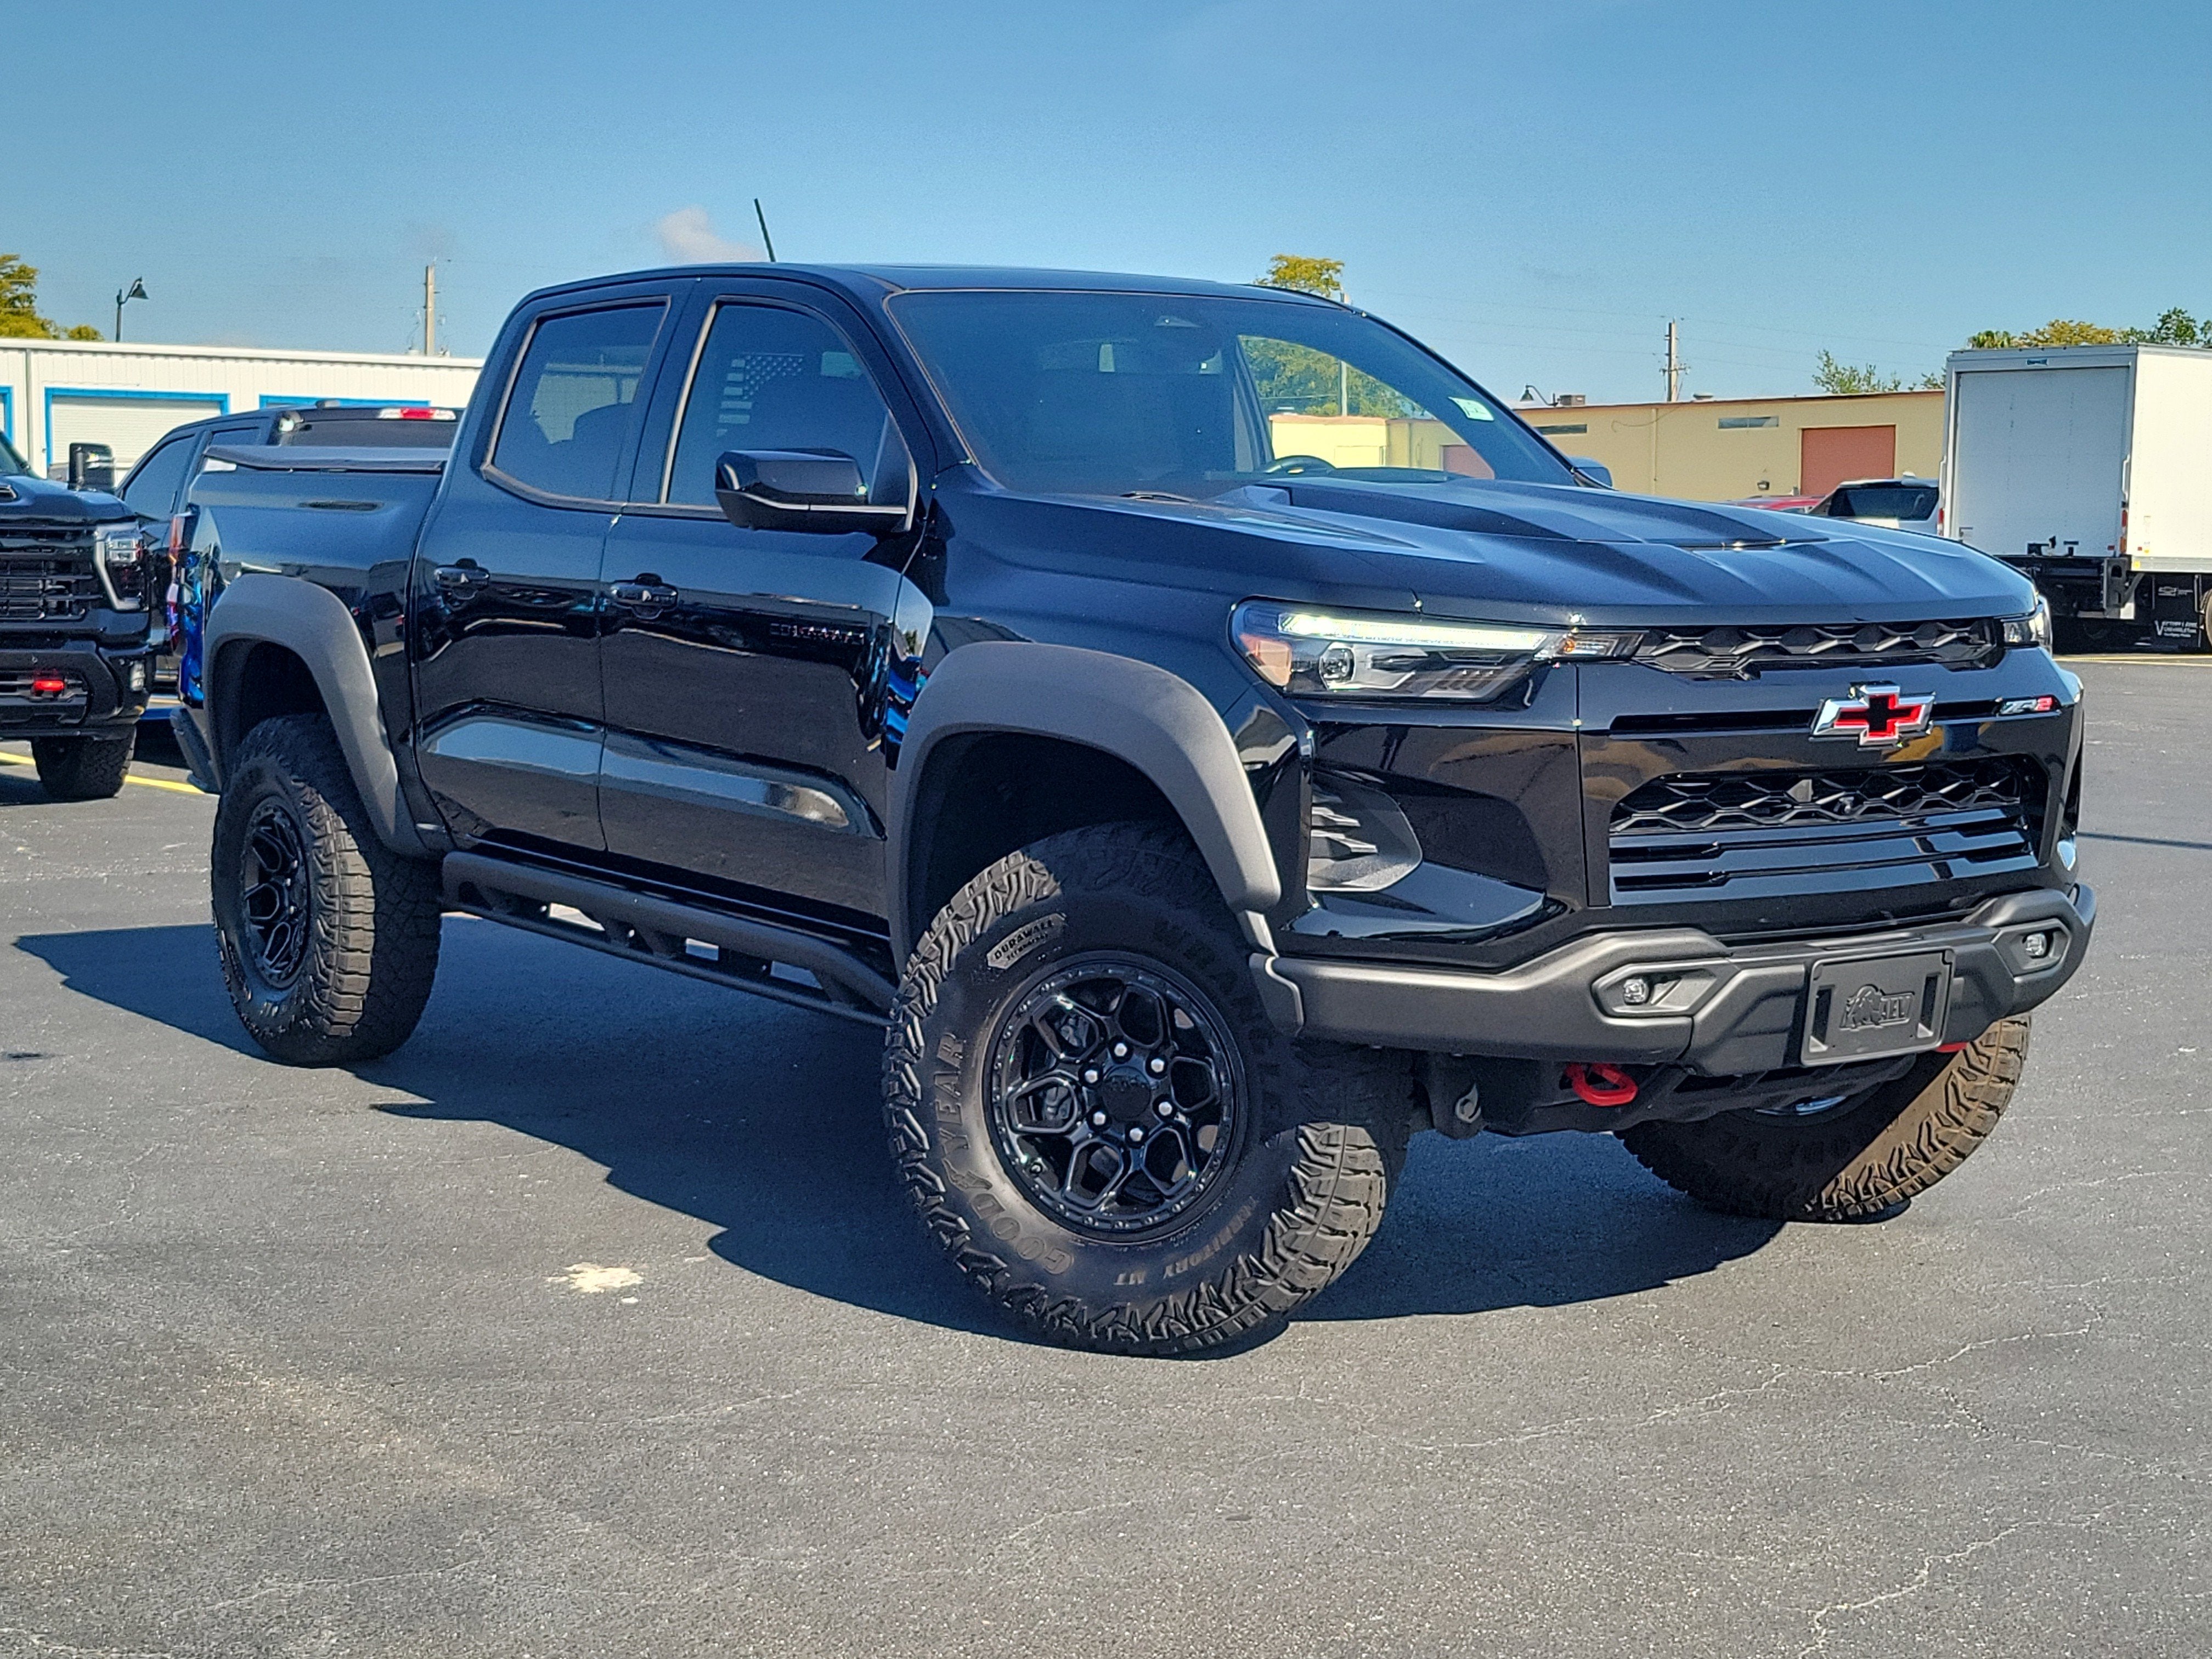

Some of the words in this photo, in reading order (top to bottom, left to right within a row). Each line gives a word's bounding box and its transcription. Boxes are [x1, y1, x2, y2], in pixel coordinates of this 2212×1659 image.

[2000, 697, 2052, 715] ZR2
[994, 919, 1054, 960] DURAWALL
[936, 1032, 1074, 1275] GOODYEAR
